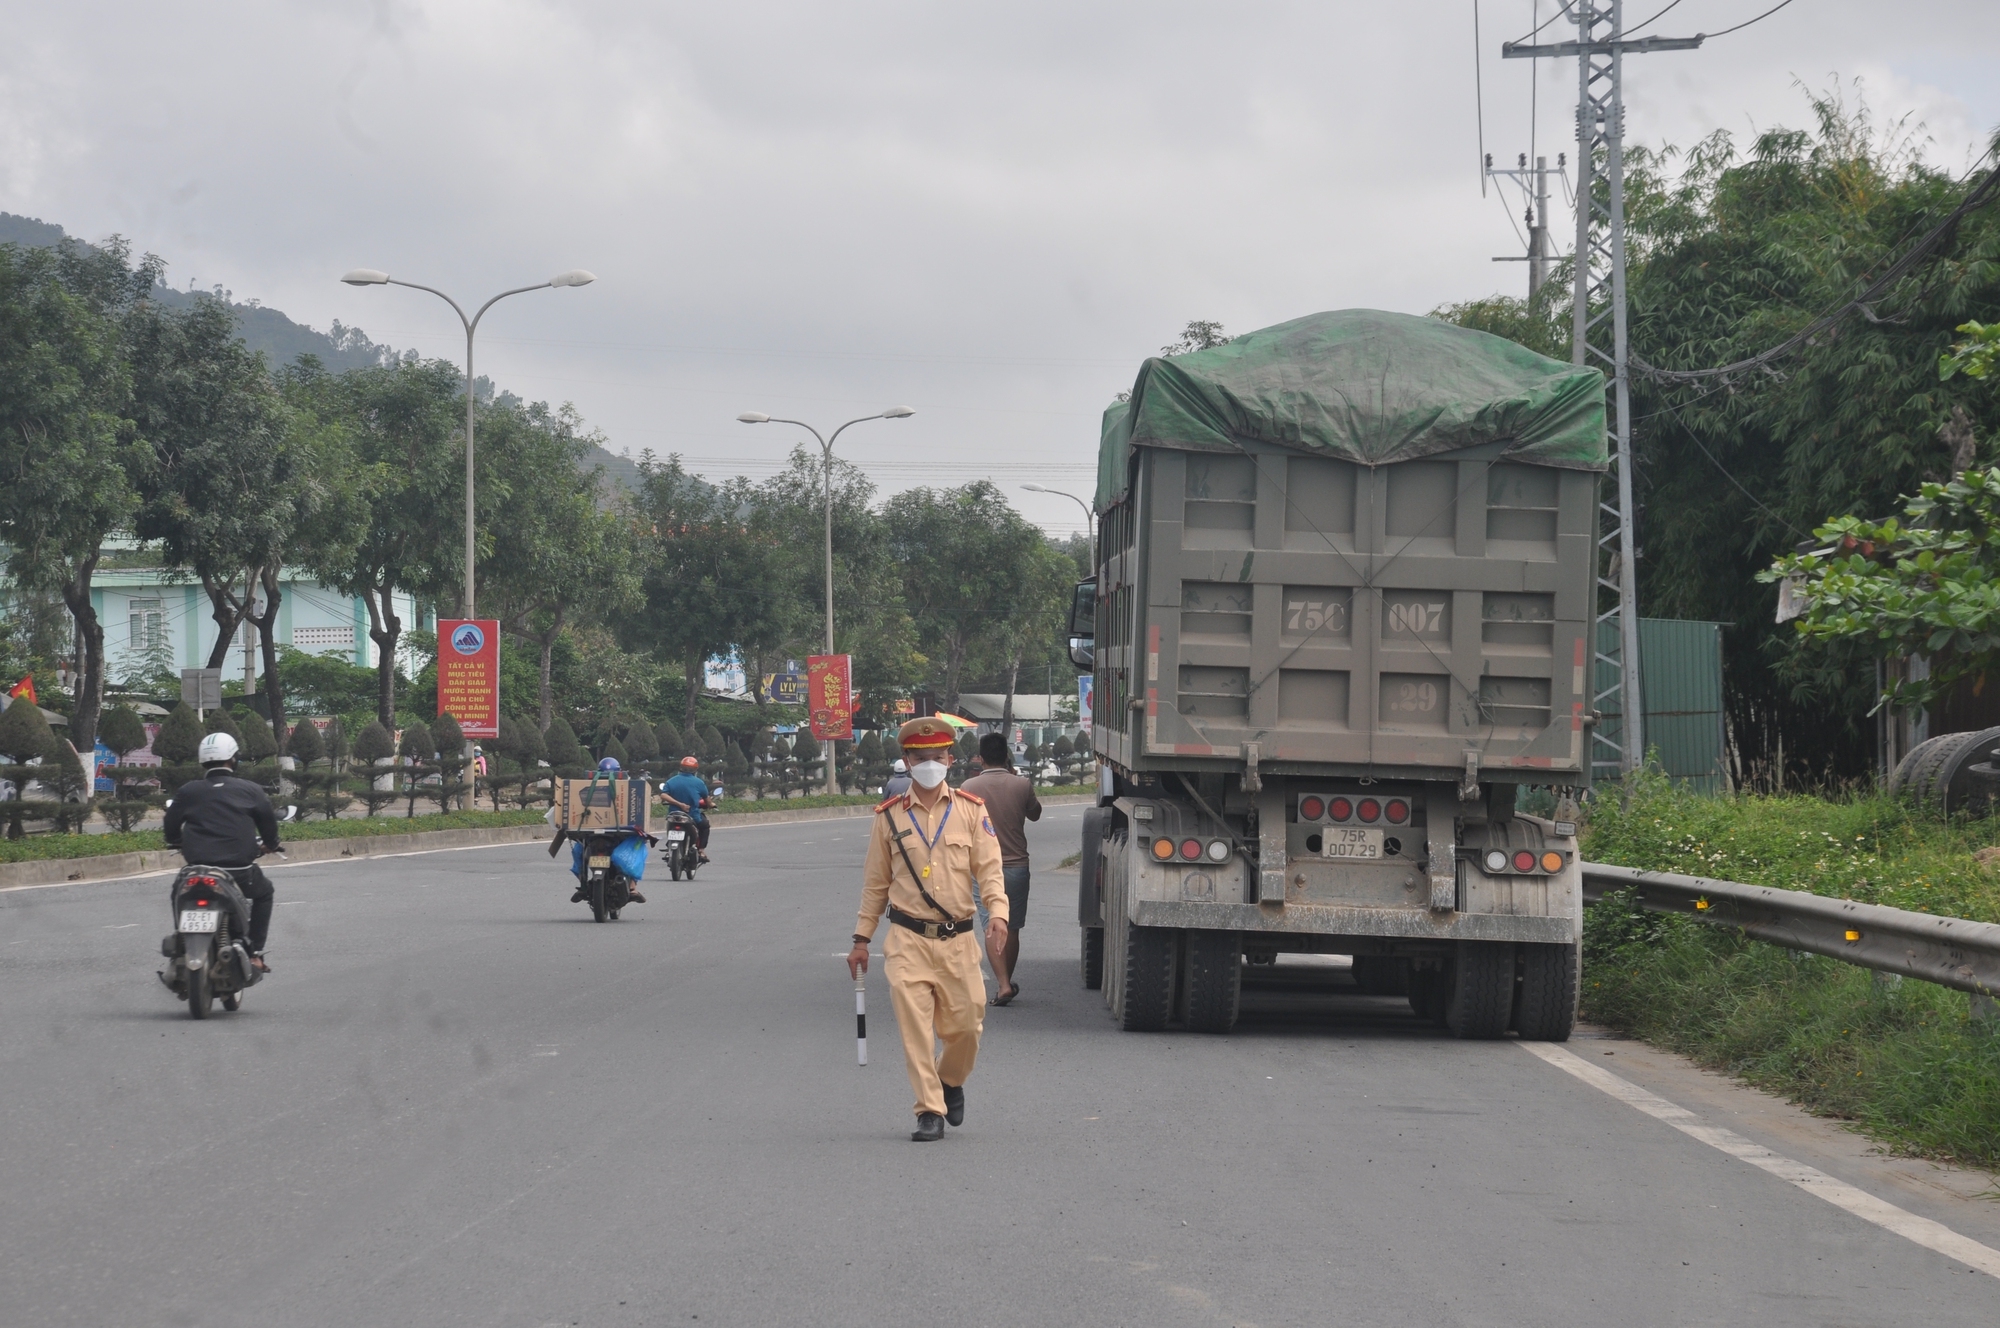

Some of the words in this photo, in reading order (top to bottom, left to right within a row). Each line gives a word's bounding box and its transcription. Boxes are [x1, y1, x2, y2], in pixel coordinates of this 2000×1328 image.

[1287, 601, 1345, 632] 75C
[1389, 602, 1446, 632] 007
[1341, 829, 1366, 842] 75R
[1329, 843, 1376, 857] 007.29
[187, 912, 211, 921] 92-E1
